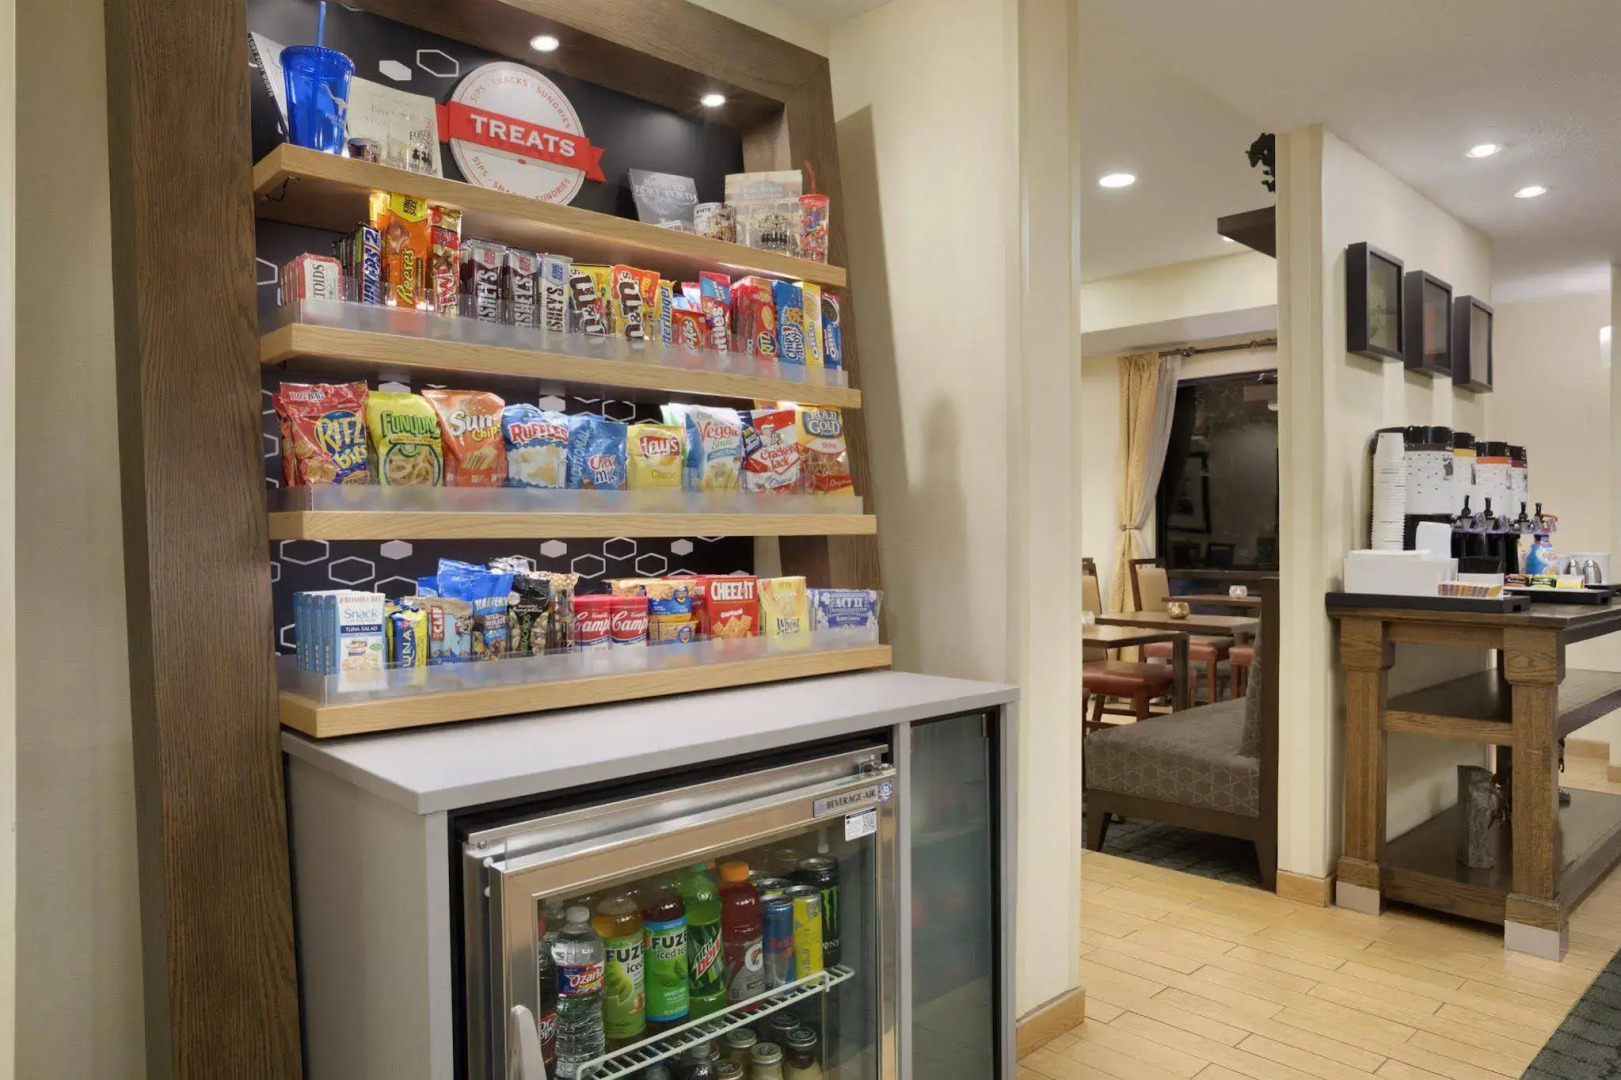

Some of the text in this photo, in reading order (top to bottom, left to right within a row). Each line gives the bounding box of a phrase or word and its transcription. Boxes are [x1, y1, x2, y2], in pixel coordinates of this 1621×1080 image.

[490, 76, 528, 87] SNACKS
[536, 86, 571, 129] SUNDRIES
[470, 113, 576, 157] TREATS
[472, 156, 488, 177] SIPS
[313, 263, 326, 299] TOIDS
[660, 286, 673, 347] tterfinger
[760, 333, 774, 355] RITZ
[784, 333, 797, 359] Chips
[808, 322, 820, 360] OREO
[827, 325, 838, 360] OREO
[289, 391, 324, 401] BIG BAG
[316, 416, 365, 454] RITZ
[449, 410, 493, 437] Sun
[509, 422, 568, 444] RUFFLES
[808, 420, 840, 434] GOLD
[334, 444, 367, 469] bits
[640, 435, 681, 457] Lay's
[589, 454, 616, 471] Chex
[651, 469, 677, 479] Classic
[344, 609, 379, 619] Snack
[402, 628, 414, 668] UNA
[657, 948, 676, 960] iced
